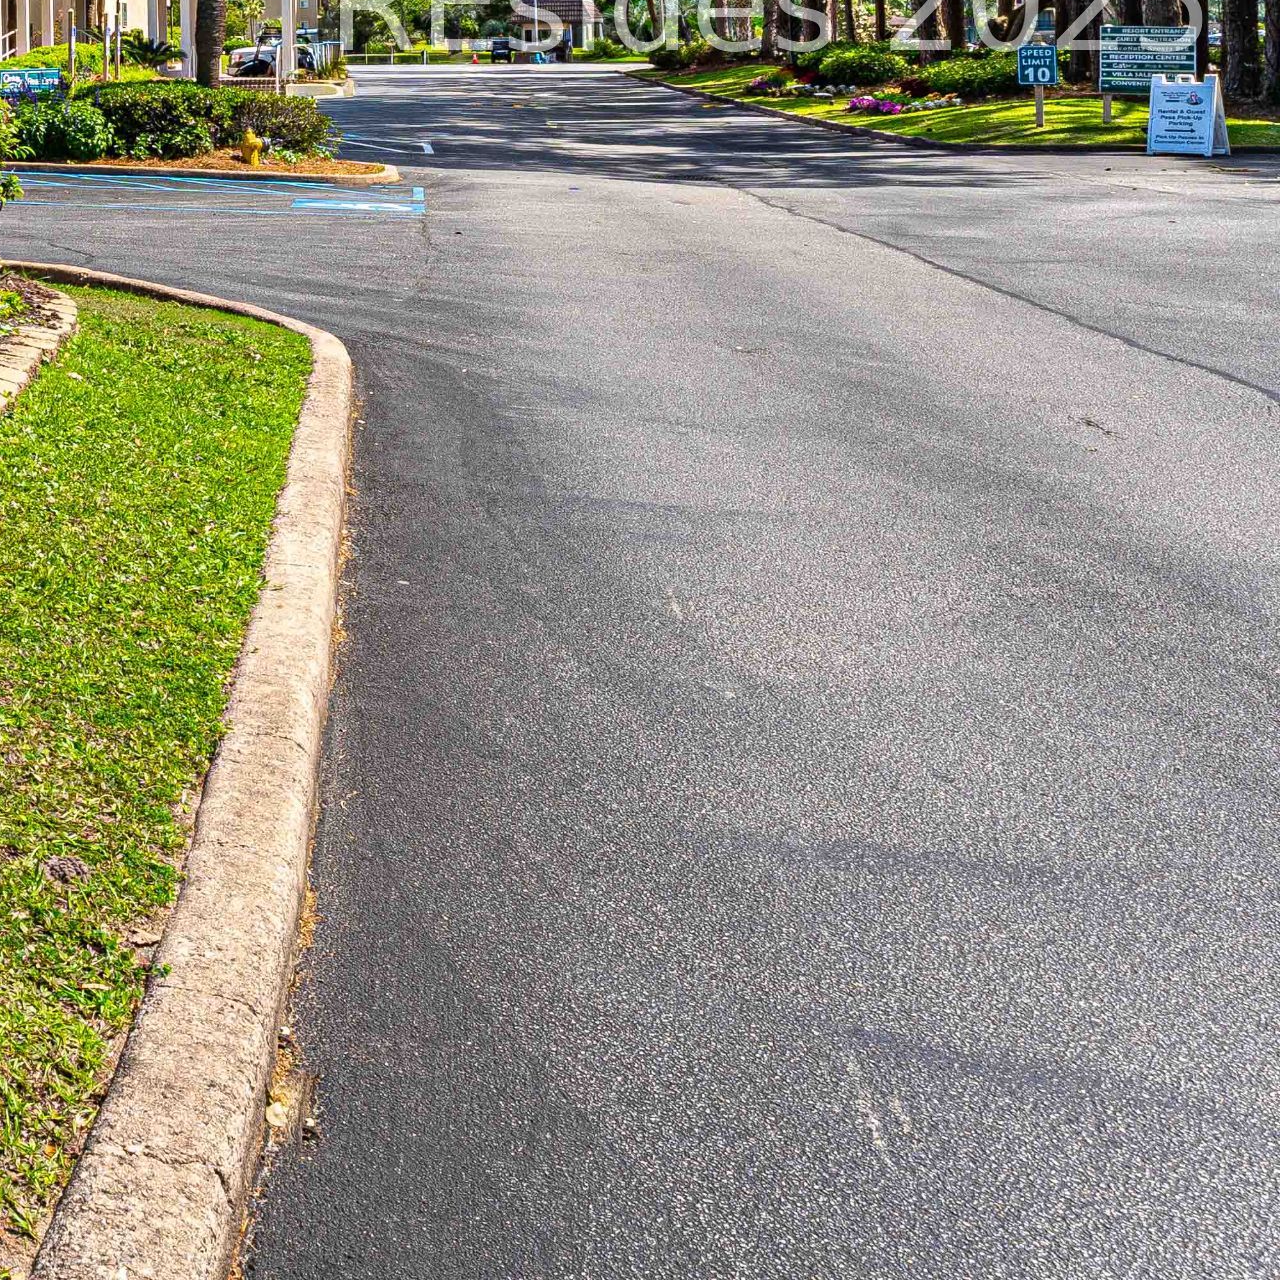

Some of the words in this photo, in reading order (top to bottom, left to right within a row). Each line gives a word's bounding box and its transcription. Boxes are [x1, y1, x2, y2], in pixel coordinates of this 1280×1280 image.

[1021, 49, 1052, 57] SPEED
[1022, 58, 1052, 66] LIMIT
[1024, 67, 1050, 82] 10
